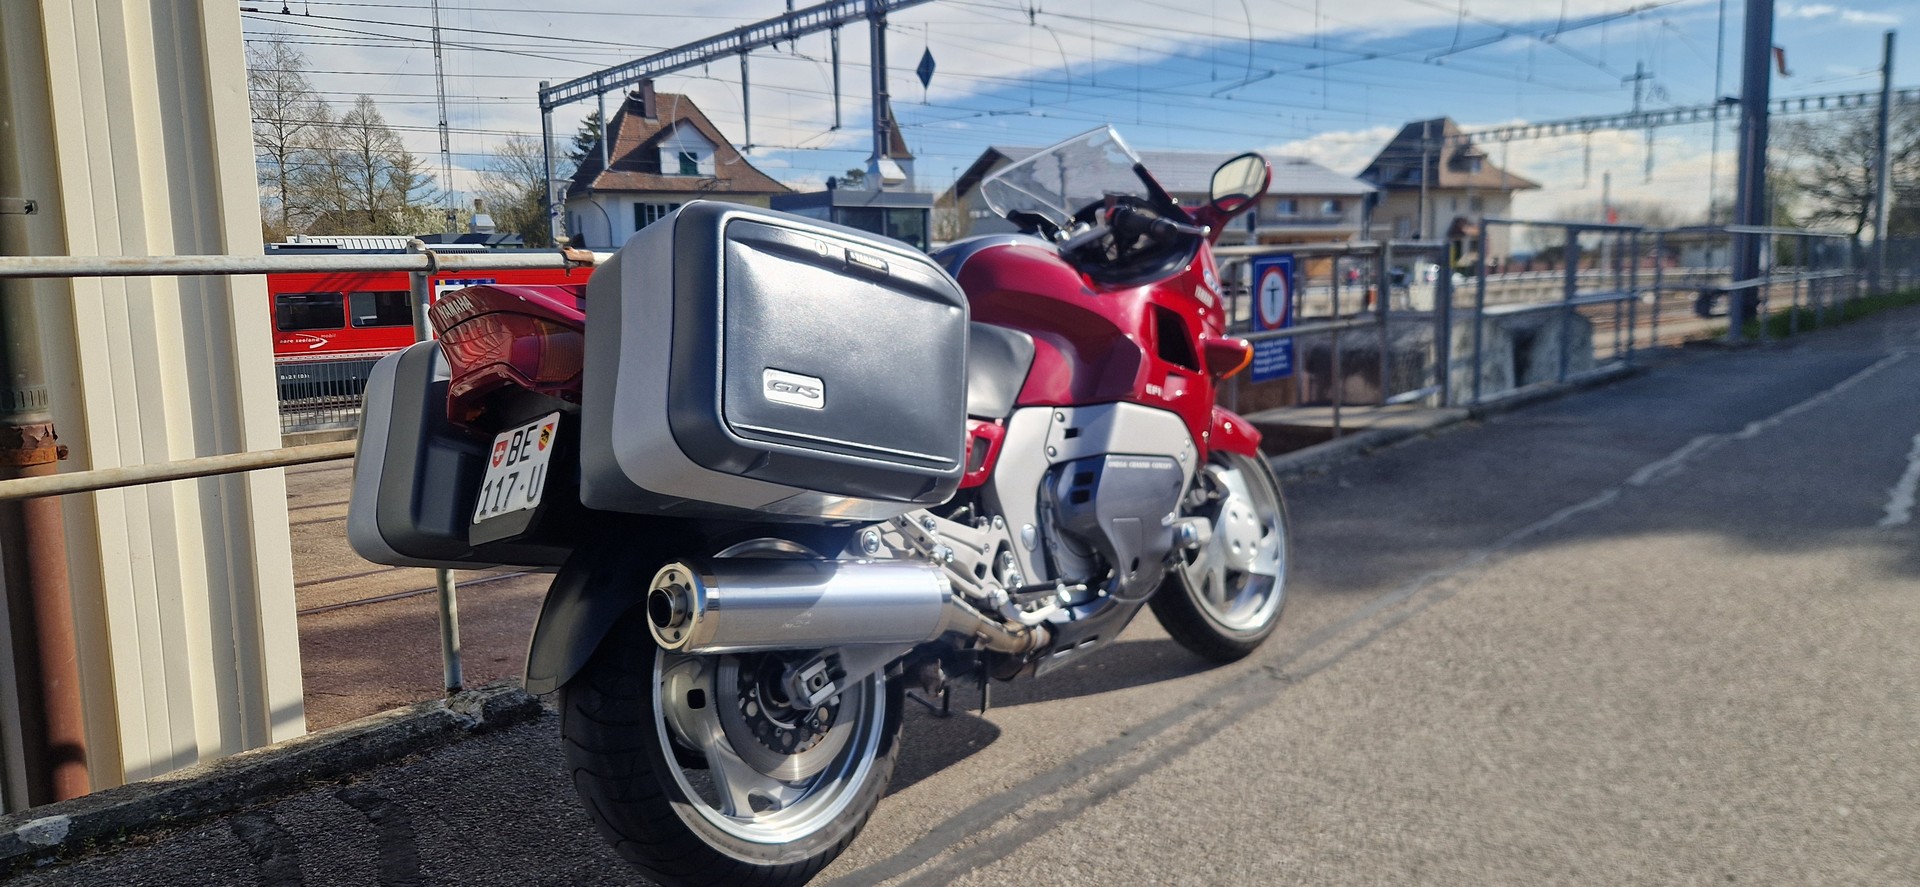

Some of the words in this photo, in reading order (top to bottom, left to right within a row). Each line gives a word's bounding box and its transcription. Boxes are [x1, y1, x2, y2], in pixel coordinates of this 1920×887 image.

[435, 295, 474, 320] YAMAHA
[766, 379, 821, 399] GTS
[506, 424, 539, 467] BE
